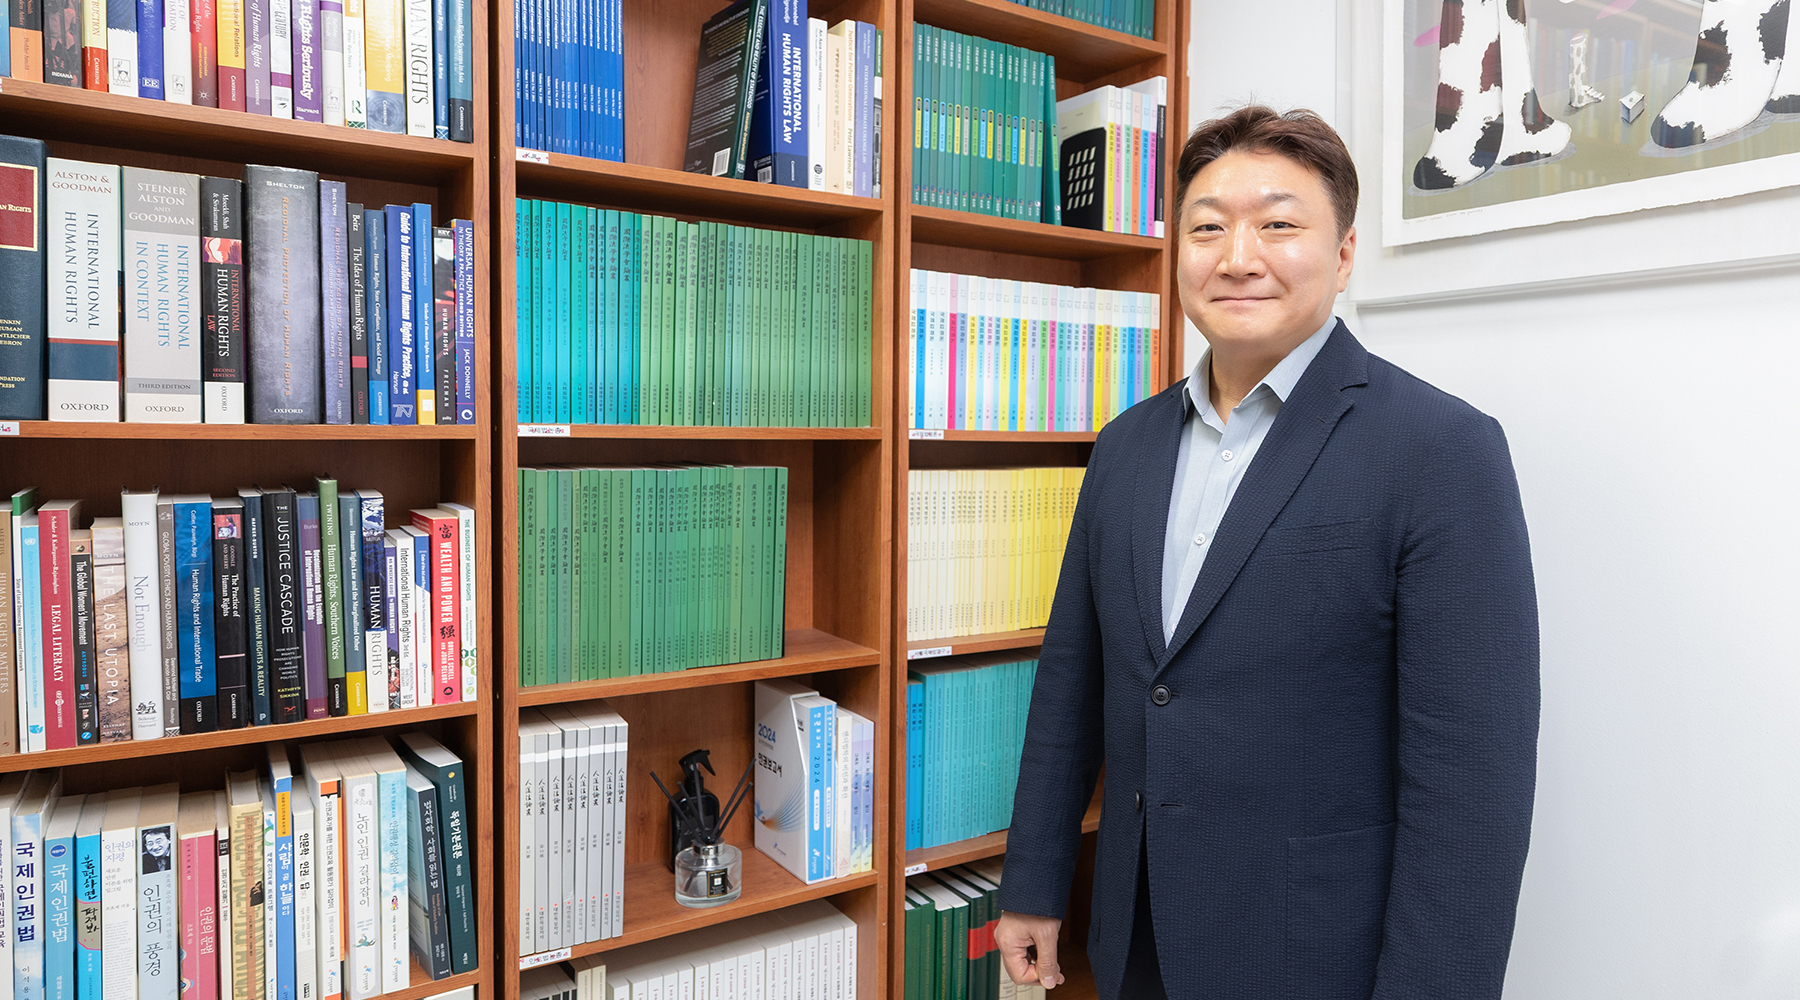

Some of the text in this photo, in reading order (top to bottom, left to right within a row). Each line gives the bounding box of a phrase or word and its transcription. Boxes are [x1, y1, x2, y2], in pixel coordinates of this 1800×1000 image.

[253, 12, 261, 41] Human
[275, 11, 286, 38] CENTURY
[756, 16, 764, 38] ESSENCE
[251, 43, 262, 67] Rights
[299, 5, 314, 99] Rights Seriously
[411, 42, 428, 104] RIGHTS
[751, 51, 759, 71] REALITY
[52, 71, 73, 79] INDIANA
[746, 80, 755, 109] STATEHOOD
[783, 33, 791, 143] HUMAN RIGHTS LAW
[793, 47, 801, 132] INTERNATIONAL
[297, 106, 319, 114] Harvard
[52, 181, 111, 194] GOODMAN
[54, 172, 97, 181] ALSTON
[137, 183, 187, 195] STEINER
[267, 181, 305, 189] SHELTON
[129, 212, 195, 226] GOODMAN
[138, 195, 184, 206] ALSTON
[352, 214, 360, 231] Beitz
[400, 213, 410, 234] Guide
[65, 211, 78, 324] HUMAN RIGHTS
[401, 245, 411, 291] International
[465, 228, 473, 271] UNIVERSAL
[87, 214, 99, 329] INTERNATIONAL
[136, 241, 149, 322] IN CONTEXT
[157, 243, 170, 347] HUMAN RIGHTS
[177, 245, 190, 350] INTERNATIONAL
[217, 269, 229, 357] HUMAN RIGHTS
[231, 270, 239, 333] INTERNATIONAL
[353, 247, 363, 340] The Idea of Human Rights
[401, 293, 412, 320] Human
[207, 315, 216, 331] LAW
[400, 322, 412, 344] Rights
[401, 346, 412, 379] Practice,
[463, 349, 471, 364] JACK
[60, 402, 109, 411] OXFORD
[326, 503, 334, 535] TWINING
[278, 517, 290, 570] JUSTICE
[221, 575, 230, 617] Human Rights
[231, 574, 239, 585] The
[440, 542, 452, 623] WEALTH AND POWER
[132, 575, 152, 652] Not Enough
[279, 575, 294, 634] CASCADE
[327, 544, 340, 660] Human Rights, Southern Voices
[51, 605, 63, 682] LEGAL LITERACY
[103, 566, 119, 705] THE LAST UTOPIA
[191, 569, 203, 682] Human Rights and International Trade
[254, 615, 262, 640] HUMAN
[371, 586, 382, 676] HUMAN RIGHTS
[758, 723, 776, 743] 2024
[758, 753, 782, 778] 인권보고서
[105, 840, 134, 852] 인권의
[389, 820, 399, 875] 인권행정 길라잡이
[450, 810, 462, 859] 독일기본권론
[81, 854, 98, 900] 불편하면
[105, 852, 125, 862] 지평
[357, 813, 370, 908] 노인 인권 길라잡이
[16, 842, 35, 942] 국제인권법
[50, 864, 69, 943] 국제인권법
[143, 885, 163, 977] 인권의 풍경
[200, 906, 214, 955] 인권의 문법
